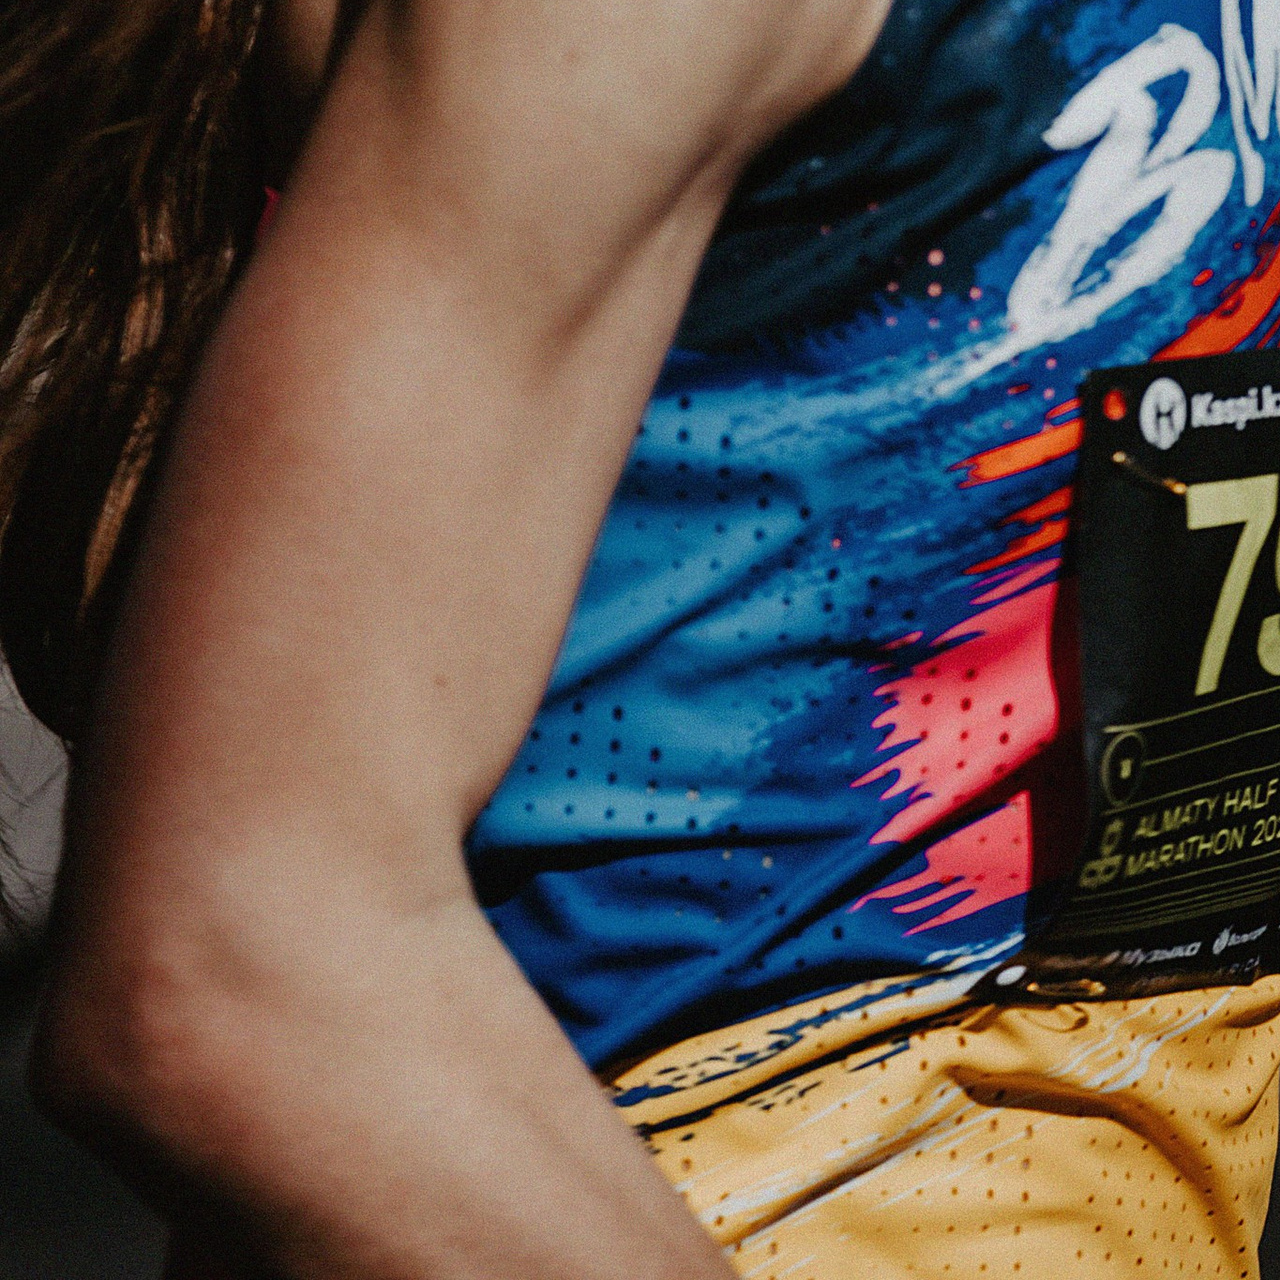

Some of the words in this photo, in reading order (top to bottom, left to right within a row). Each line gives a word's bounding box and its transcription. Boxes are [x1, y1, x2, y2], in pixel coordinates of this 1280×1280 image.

[1135, 796, 1220, 838] ALMATY
[1222, 778, 1279, 816] HALF
[1124, 825, 1248, 877] MARATHON
